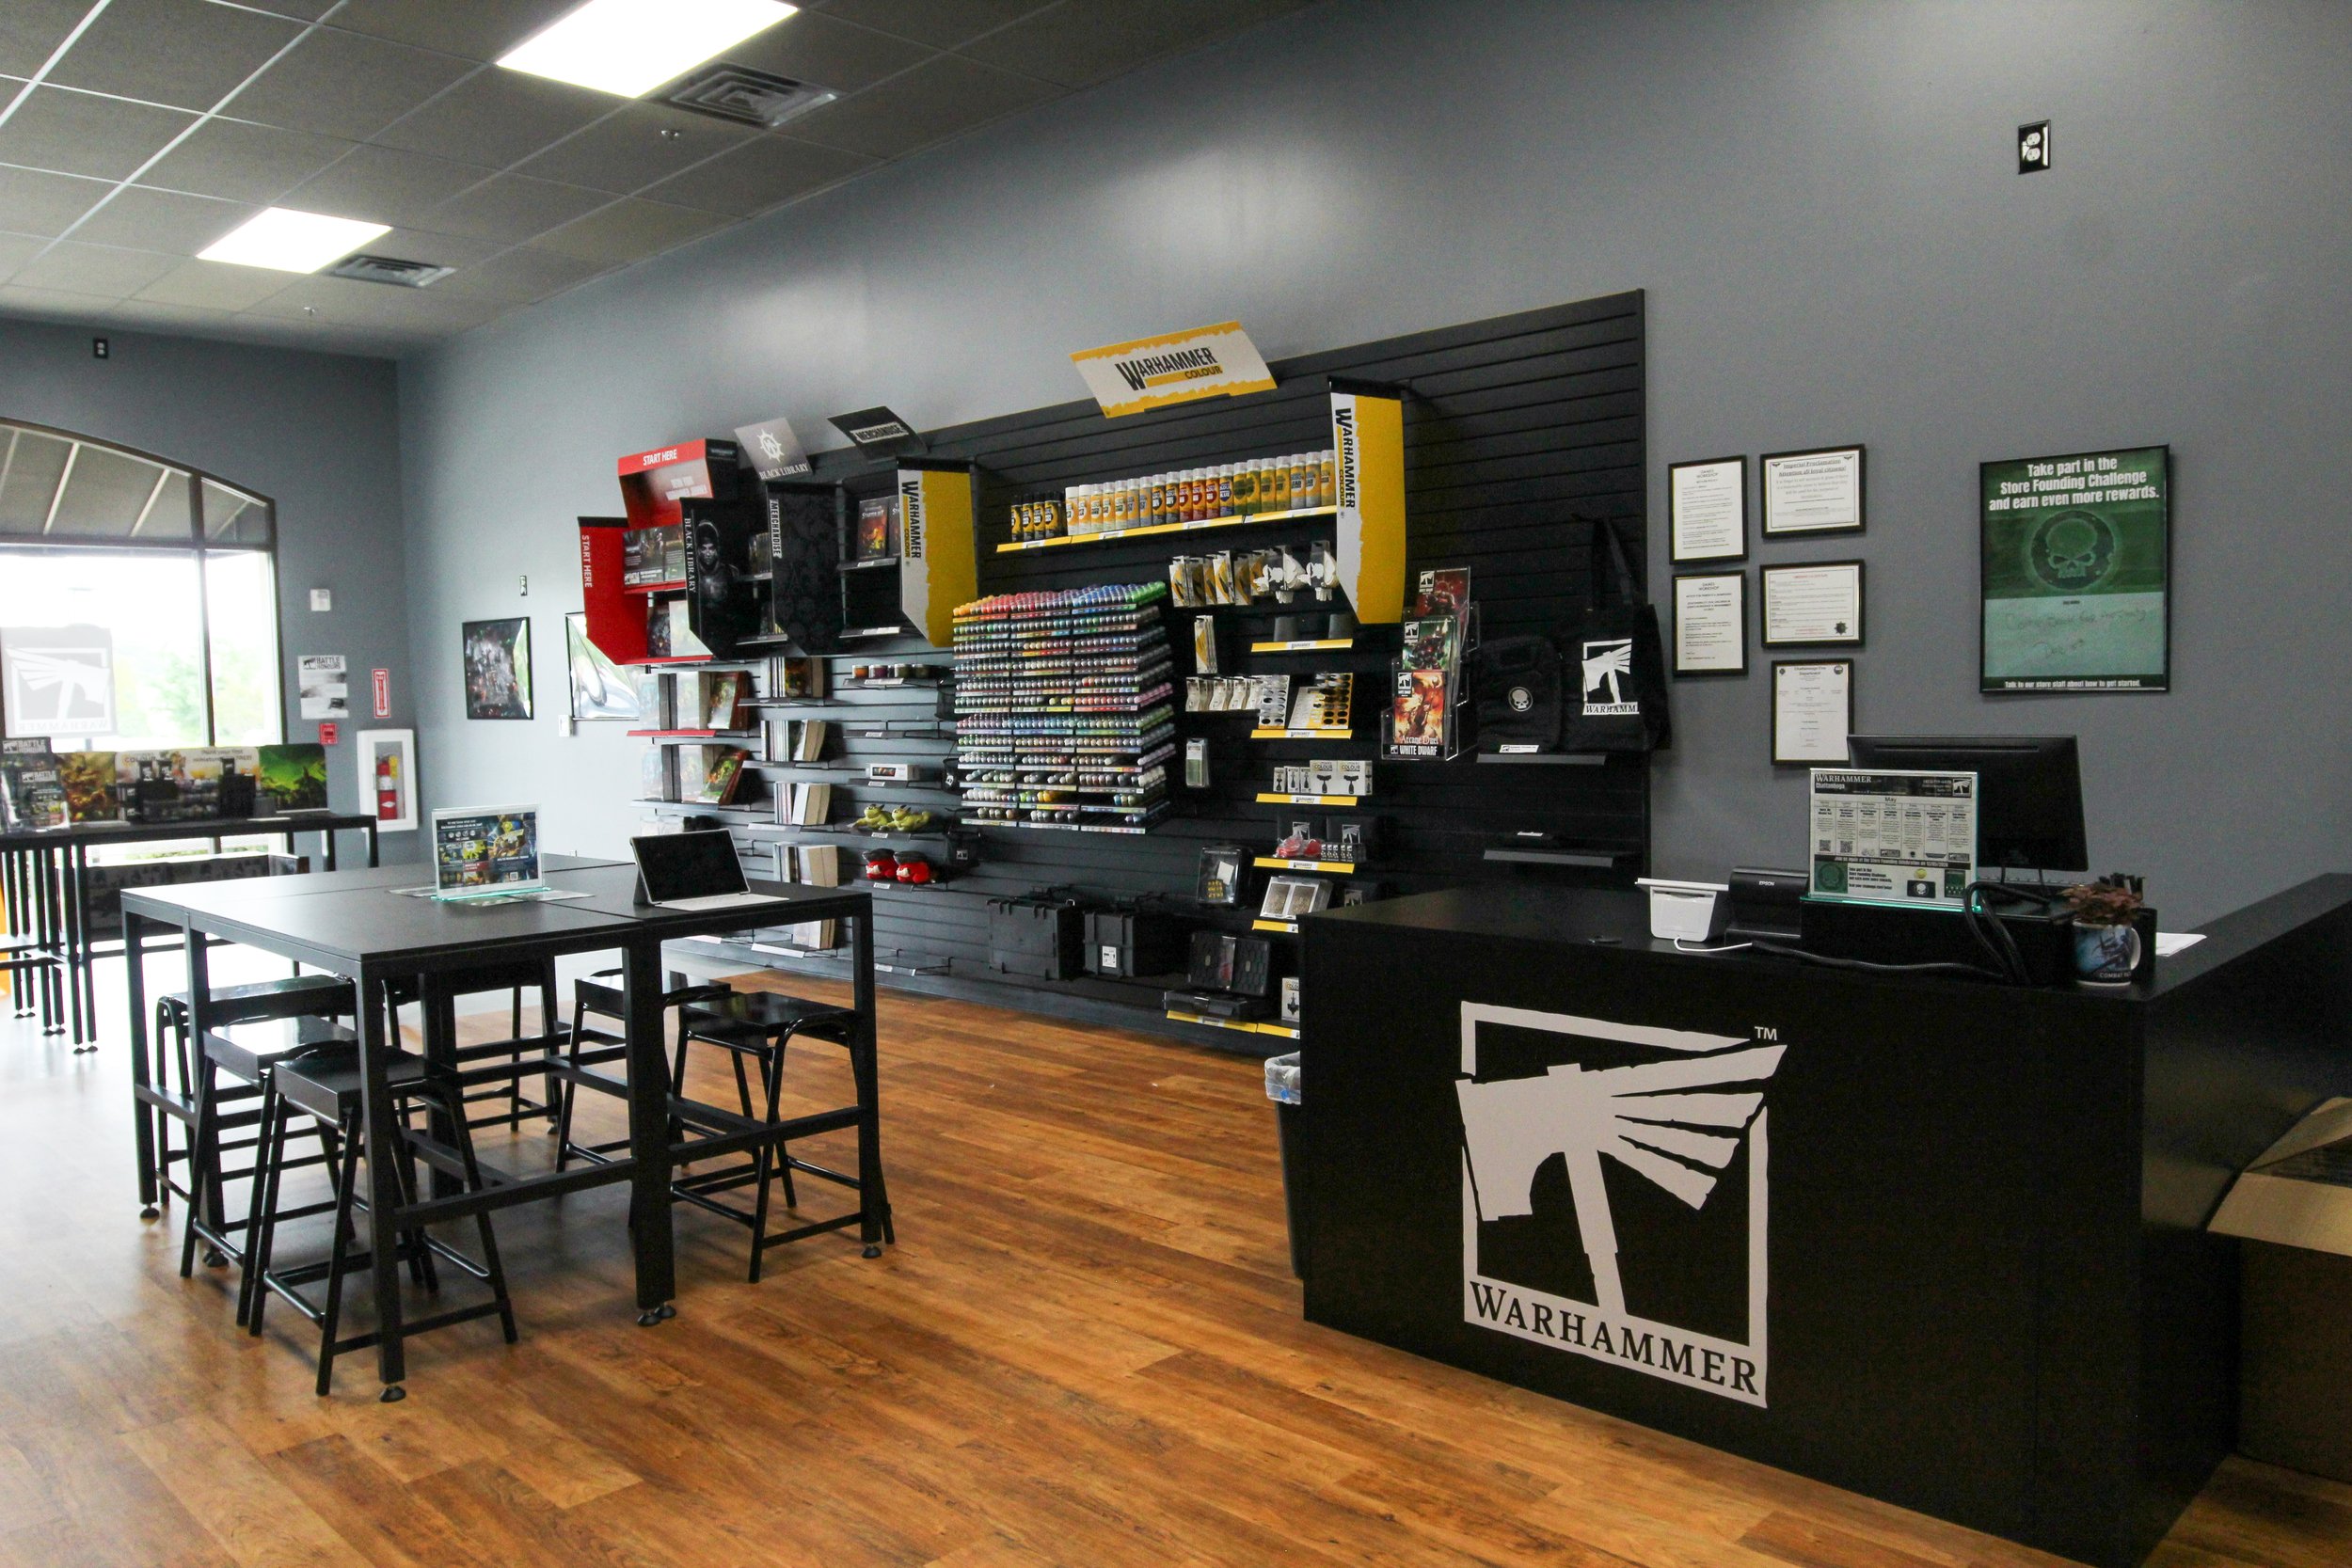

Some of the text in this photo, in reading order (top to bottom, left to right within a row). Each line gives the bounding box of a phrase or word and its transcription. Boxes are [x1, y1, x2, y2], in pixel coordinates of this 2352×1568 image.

[1114, 347, 1218, 391] WARHAMMER
[1184, 365, 1223, 380] COLOUR
[855, 423, 903, 441] MERCHANDISE
[643, 449, 677, 467] START HERE
[1335, 408, 1356, 509] WARHAMMER
[2027, 457, 2118, 478] Take part in the
[759, 463, 809, 481] BLACK LIBRARY
[2000, 470, 2147, 496] Store Founding Challenge
[1989, 485, 2160, 512] and earn even more rewards.
[771, 499, 782, 557] MERCHANDISE
[901, 481, 922, 559] WARHAMMER
[581, 534, 594, 588] START HERE
[684, 517, 696, 594] BLACK LIBRARY
[1399, 745, 1438, 755] WHITE DWARF
[1400, 735, 1438, 745] Arcane Duel
[1816, 772, 1871, 783] WARHAMMER
[1755, 1026, 1778, 1041] TM
[1469, 1280, 1759, 1396] WARHAMMER
